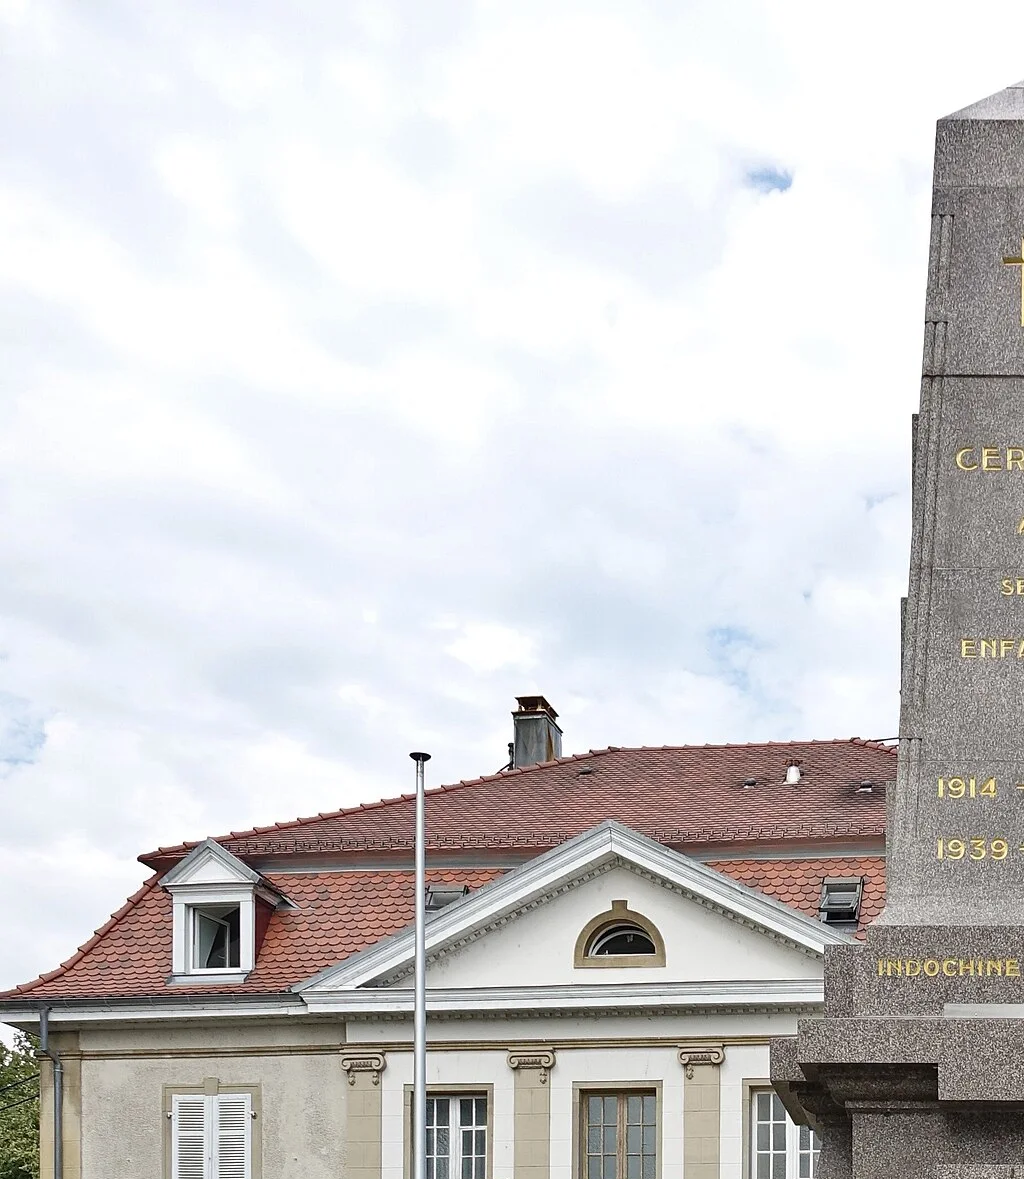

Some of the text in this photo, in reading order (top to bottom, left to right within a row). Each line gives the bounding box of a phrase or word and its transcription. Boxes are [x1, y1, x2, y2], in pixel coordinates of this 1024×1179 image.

[937, 776, 997, 798] 1914
[937, 837, 1008, 860] 1939
[877, 959, 1020, 977] INDOCHINE
